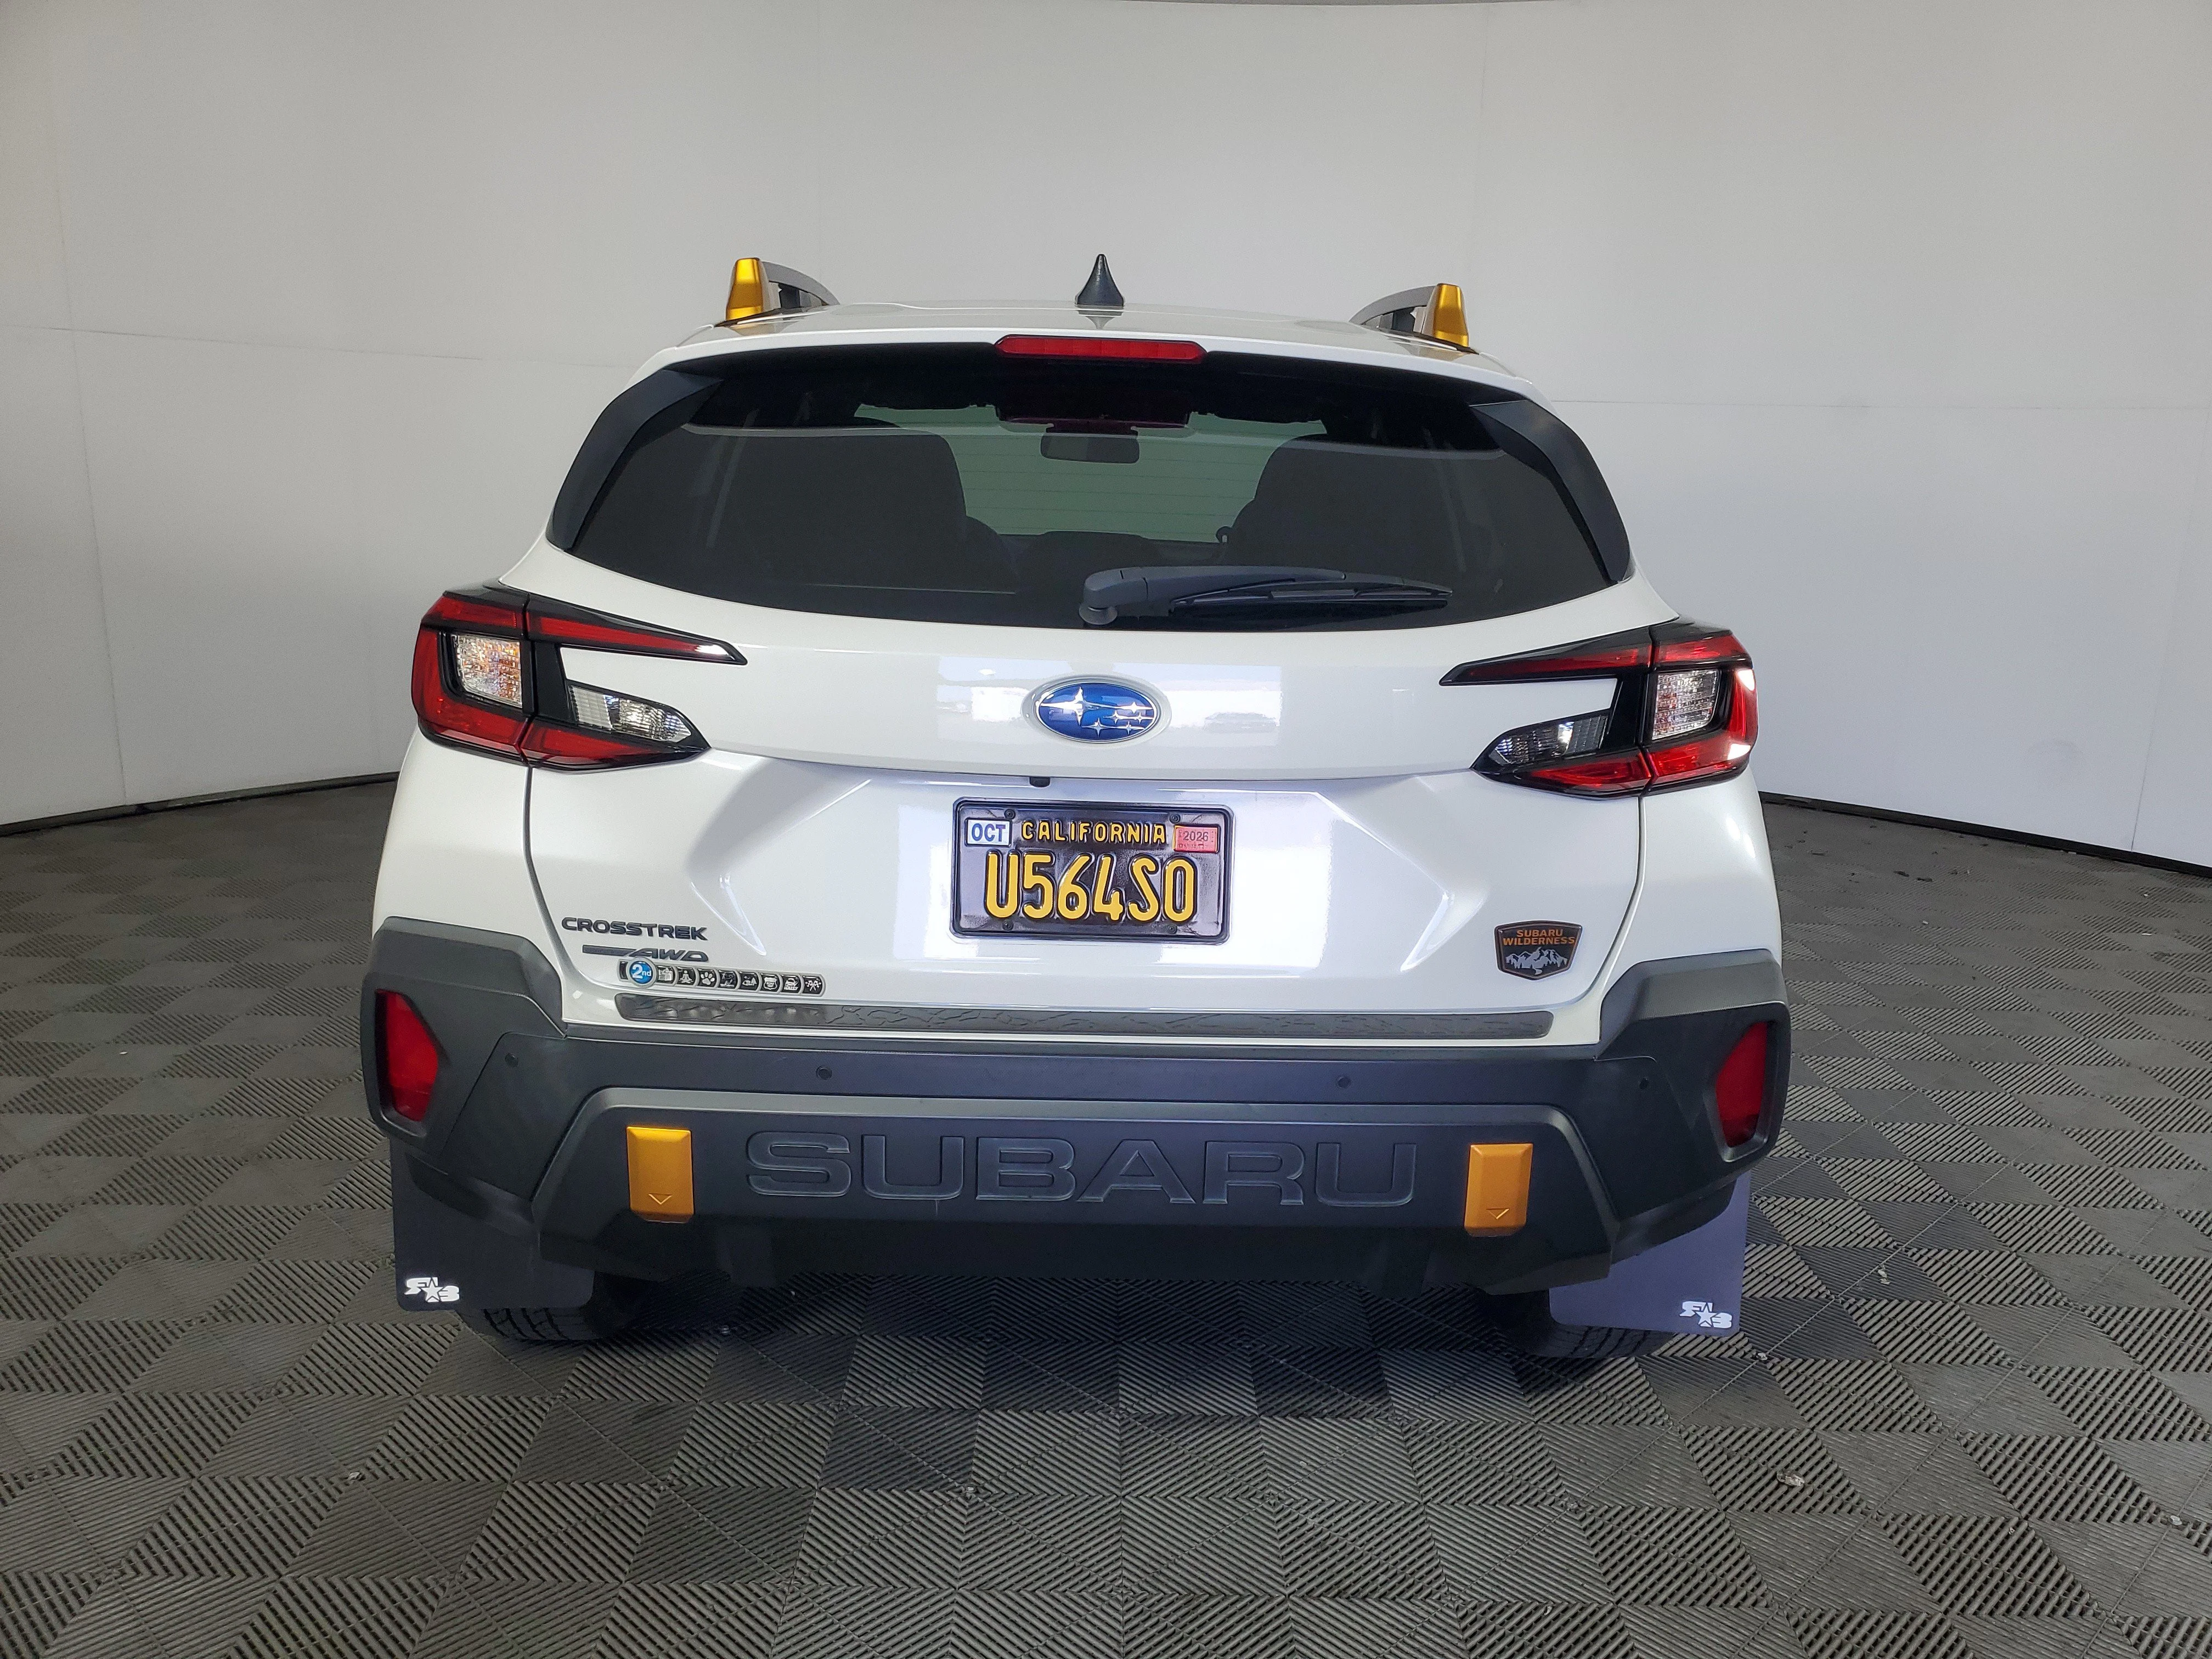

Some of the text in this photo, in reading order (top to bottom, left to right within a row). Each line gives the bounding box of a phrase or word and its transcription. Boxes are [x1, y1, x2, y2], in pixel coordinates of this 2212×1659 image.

[970, 823, 1006, 842] OCT
[1021, 821, 1166, 844] CALIFORNIA
[1183, 830, 1209, 842] 2026
[561, 916, 708, 941] CROSSTREK
[1503, 937, 1576, 945] WILDERNESS
[628, 947, 709, 962] AWD
[632, 964, 652, 979] 2nd
[746, 1130, 1418, 1206] SUBARU
